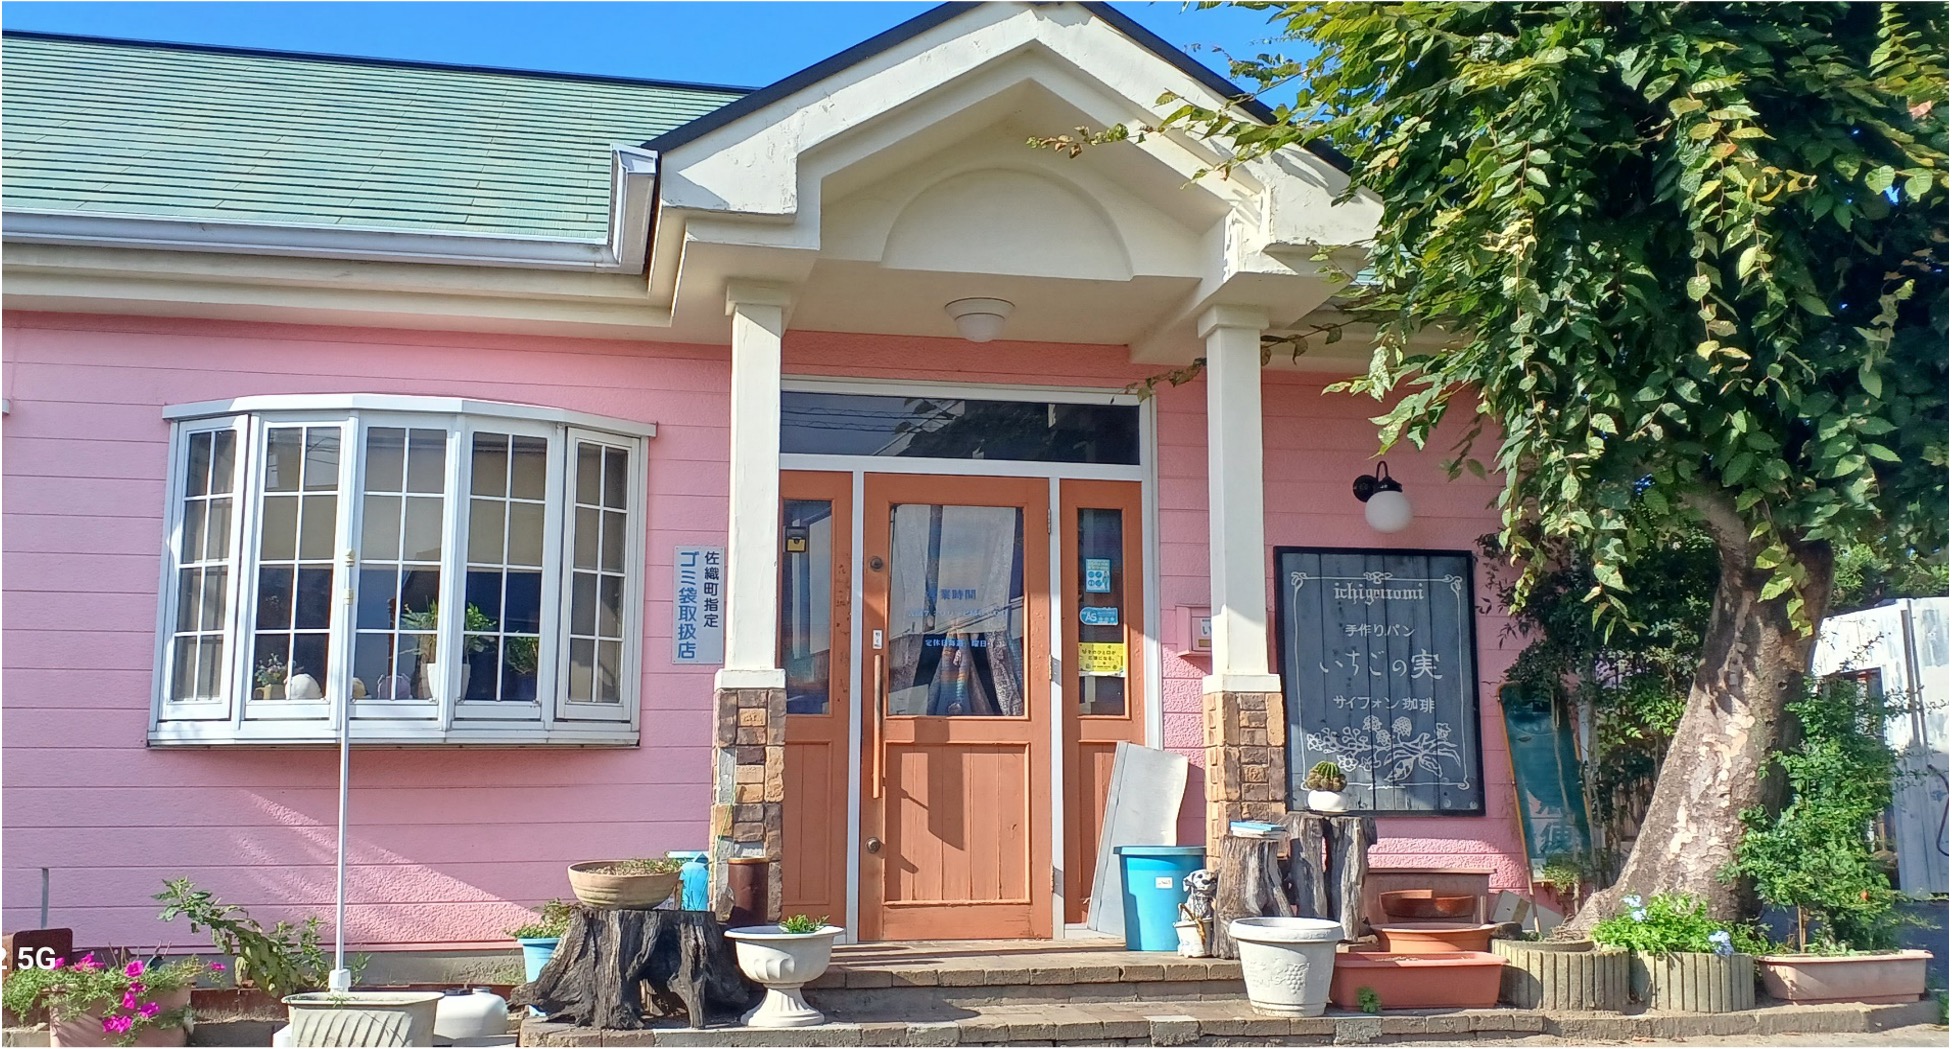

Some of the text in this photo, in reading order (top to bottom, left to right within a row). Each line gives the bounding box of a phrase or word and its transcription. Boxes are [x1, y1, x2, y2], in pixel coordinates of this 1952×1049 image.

[677, 551, 700, 659] ゴミ袋取扱店
[703, 551, 719, 628] 佐織町指定
[1345, 623, 1415, 637] 手作りパン
[1319, 648, 1443, 680] いちごの実
[1333, 695, 1436, 714] サイフォン珈琲
